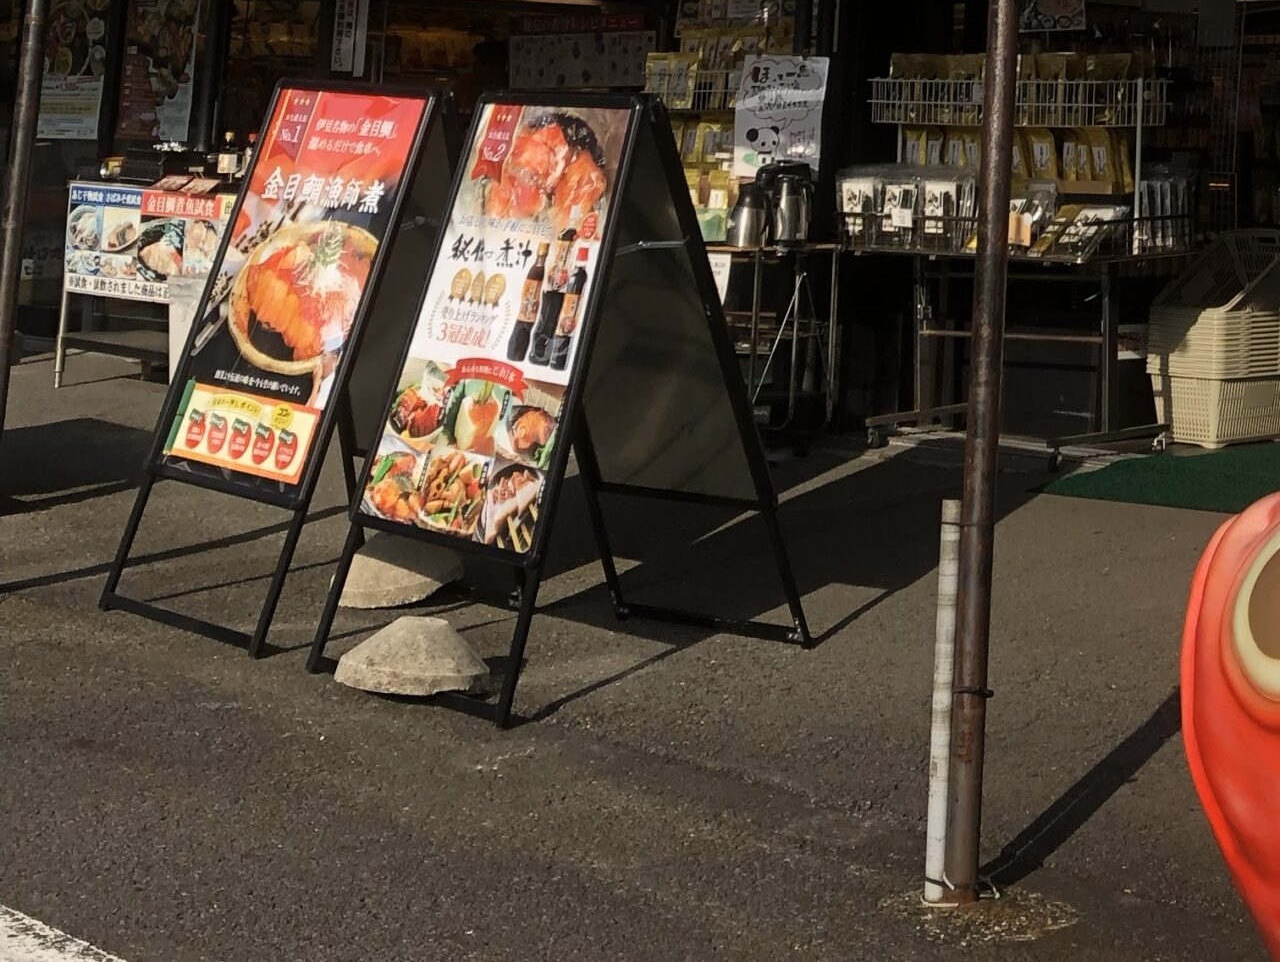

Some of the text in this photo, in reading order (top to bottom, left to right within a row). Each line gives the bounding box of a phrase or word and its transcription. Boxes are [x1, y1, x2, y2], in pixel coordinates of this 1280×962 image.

[146, 195, 214, 217] 金目鯛煮魚試食
[260, 165, 385, 214] 金目鯛漁師煮
